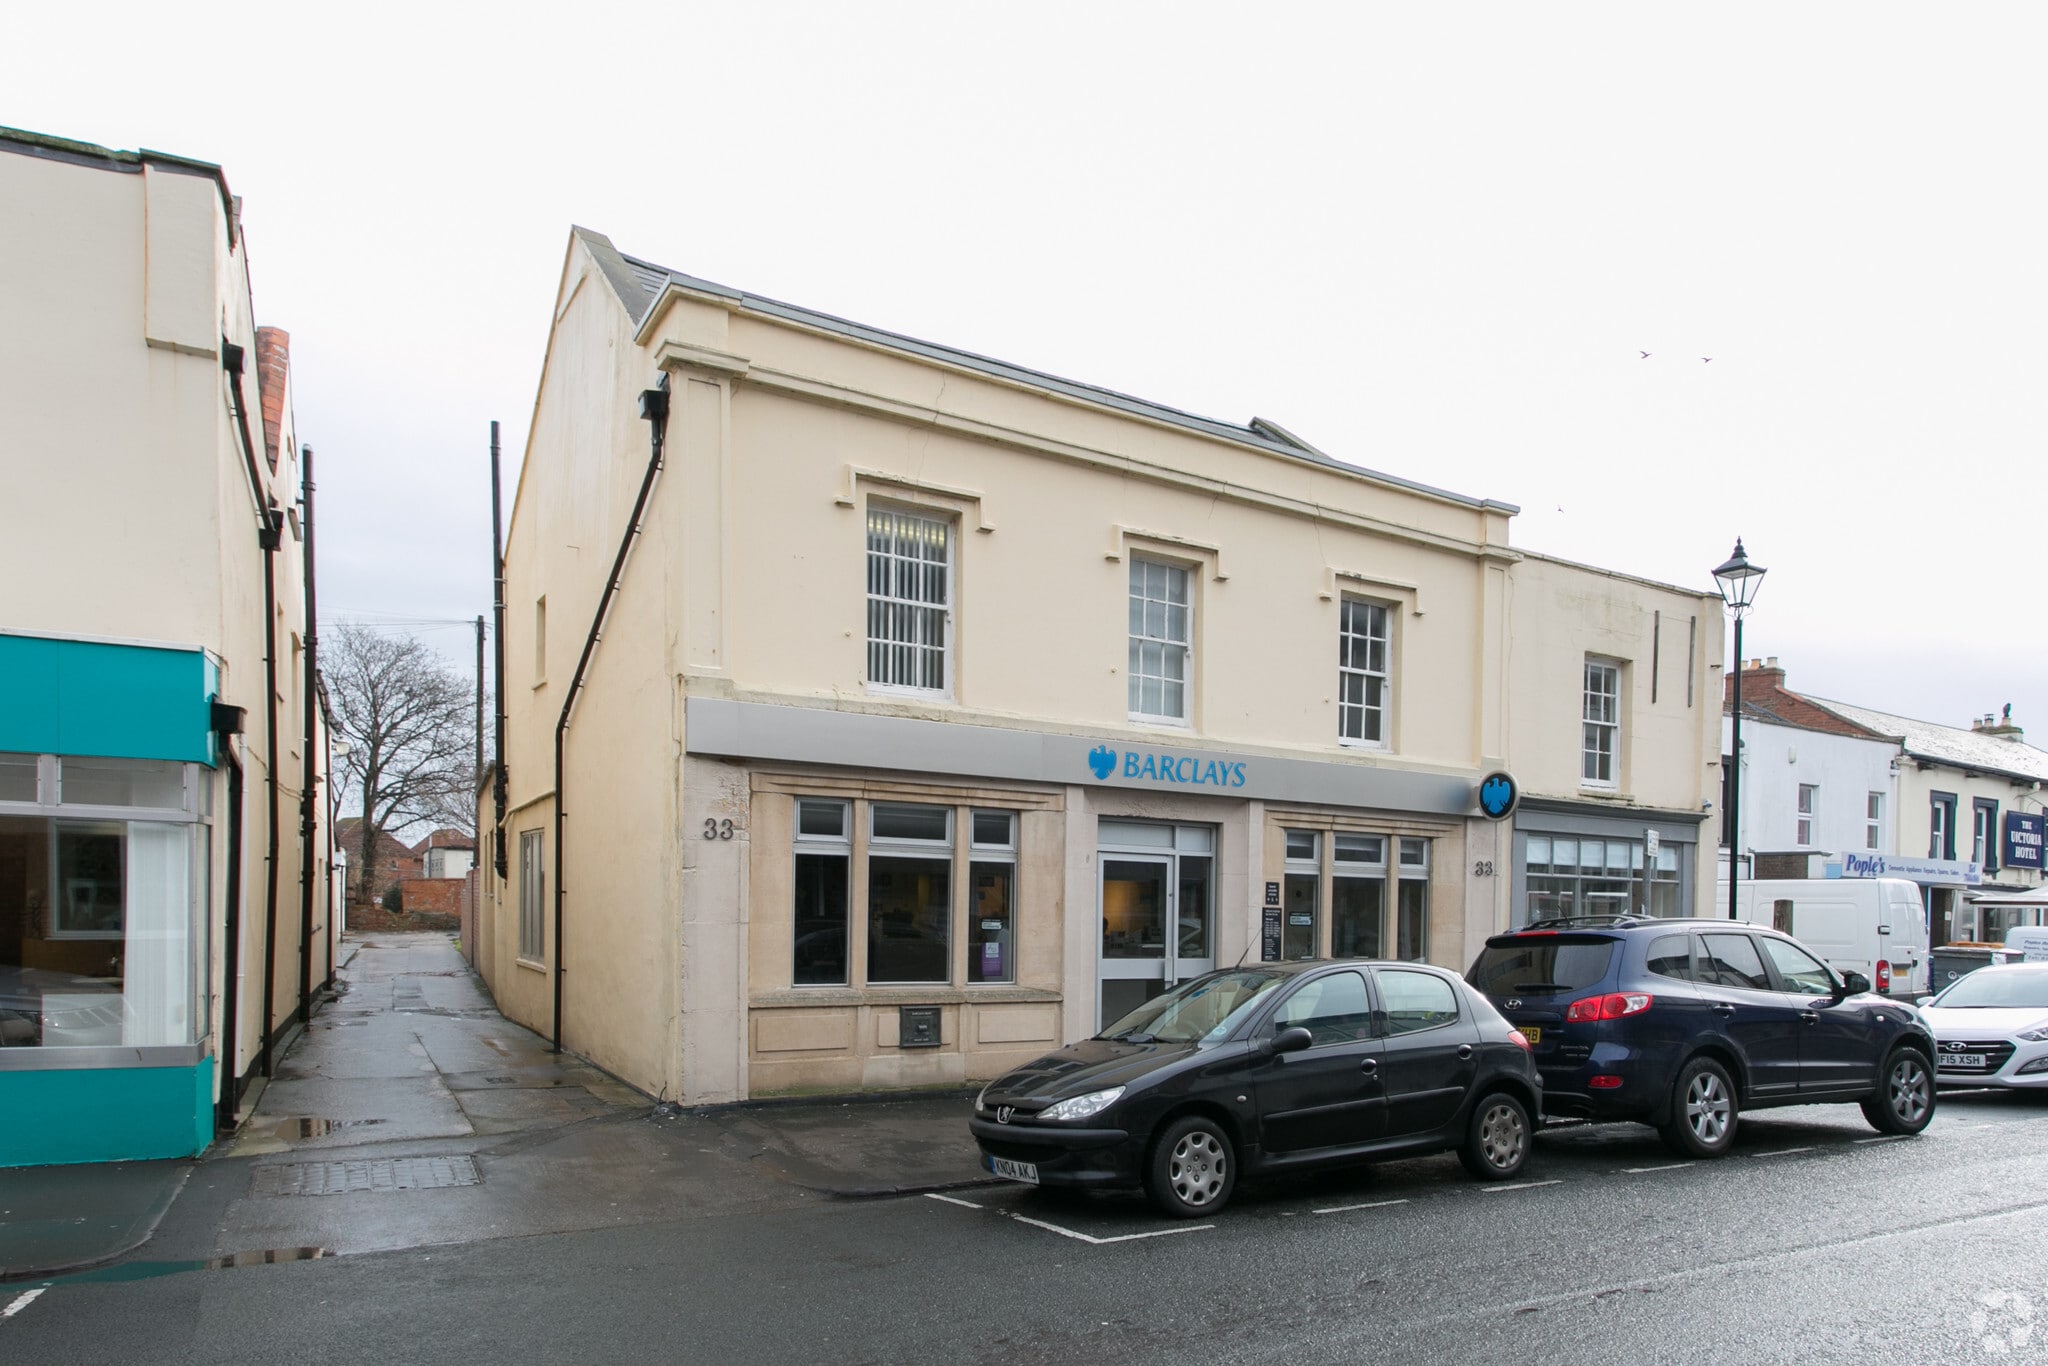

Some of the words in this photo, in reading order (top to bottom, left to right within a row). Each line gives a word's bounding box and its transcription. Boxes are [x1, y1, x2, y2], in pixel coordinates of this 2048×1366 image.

[1123, 752, 1246, 788] BARCLAYS
[704, 818, 733, 840] 33
[2021, 821, 2032, 830] THE
[2011, 831, 2042, 845] VICTORIA
[2015, 847, 2037, 860] HOTEL
[1475, 861, 1493, 876] 33
[1846, 854, 1885, 876] Pople's
[1959, 1056, 1980, 1065] XSH
[1018, 1163, 1037, 1180] AKJ
